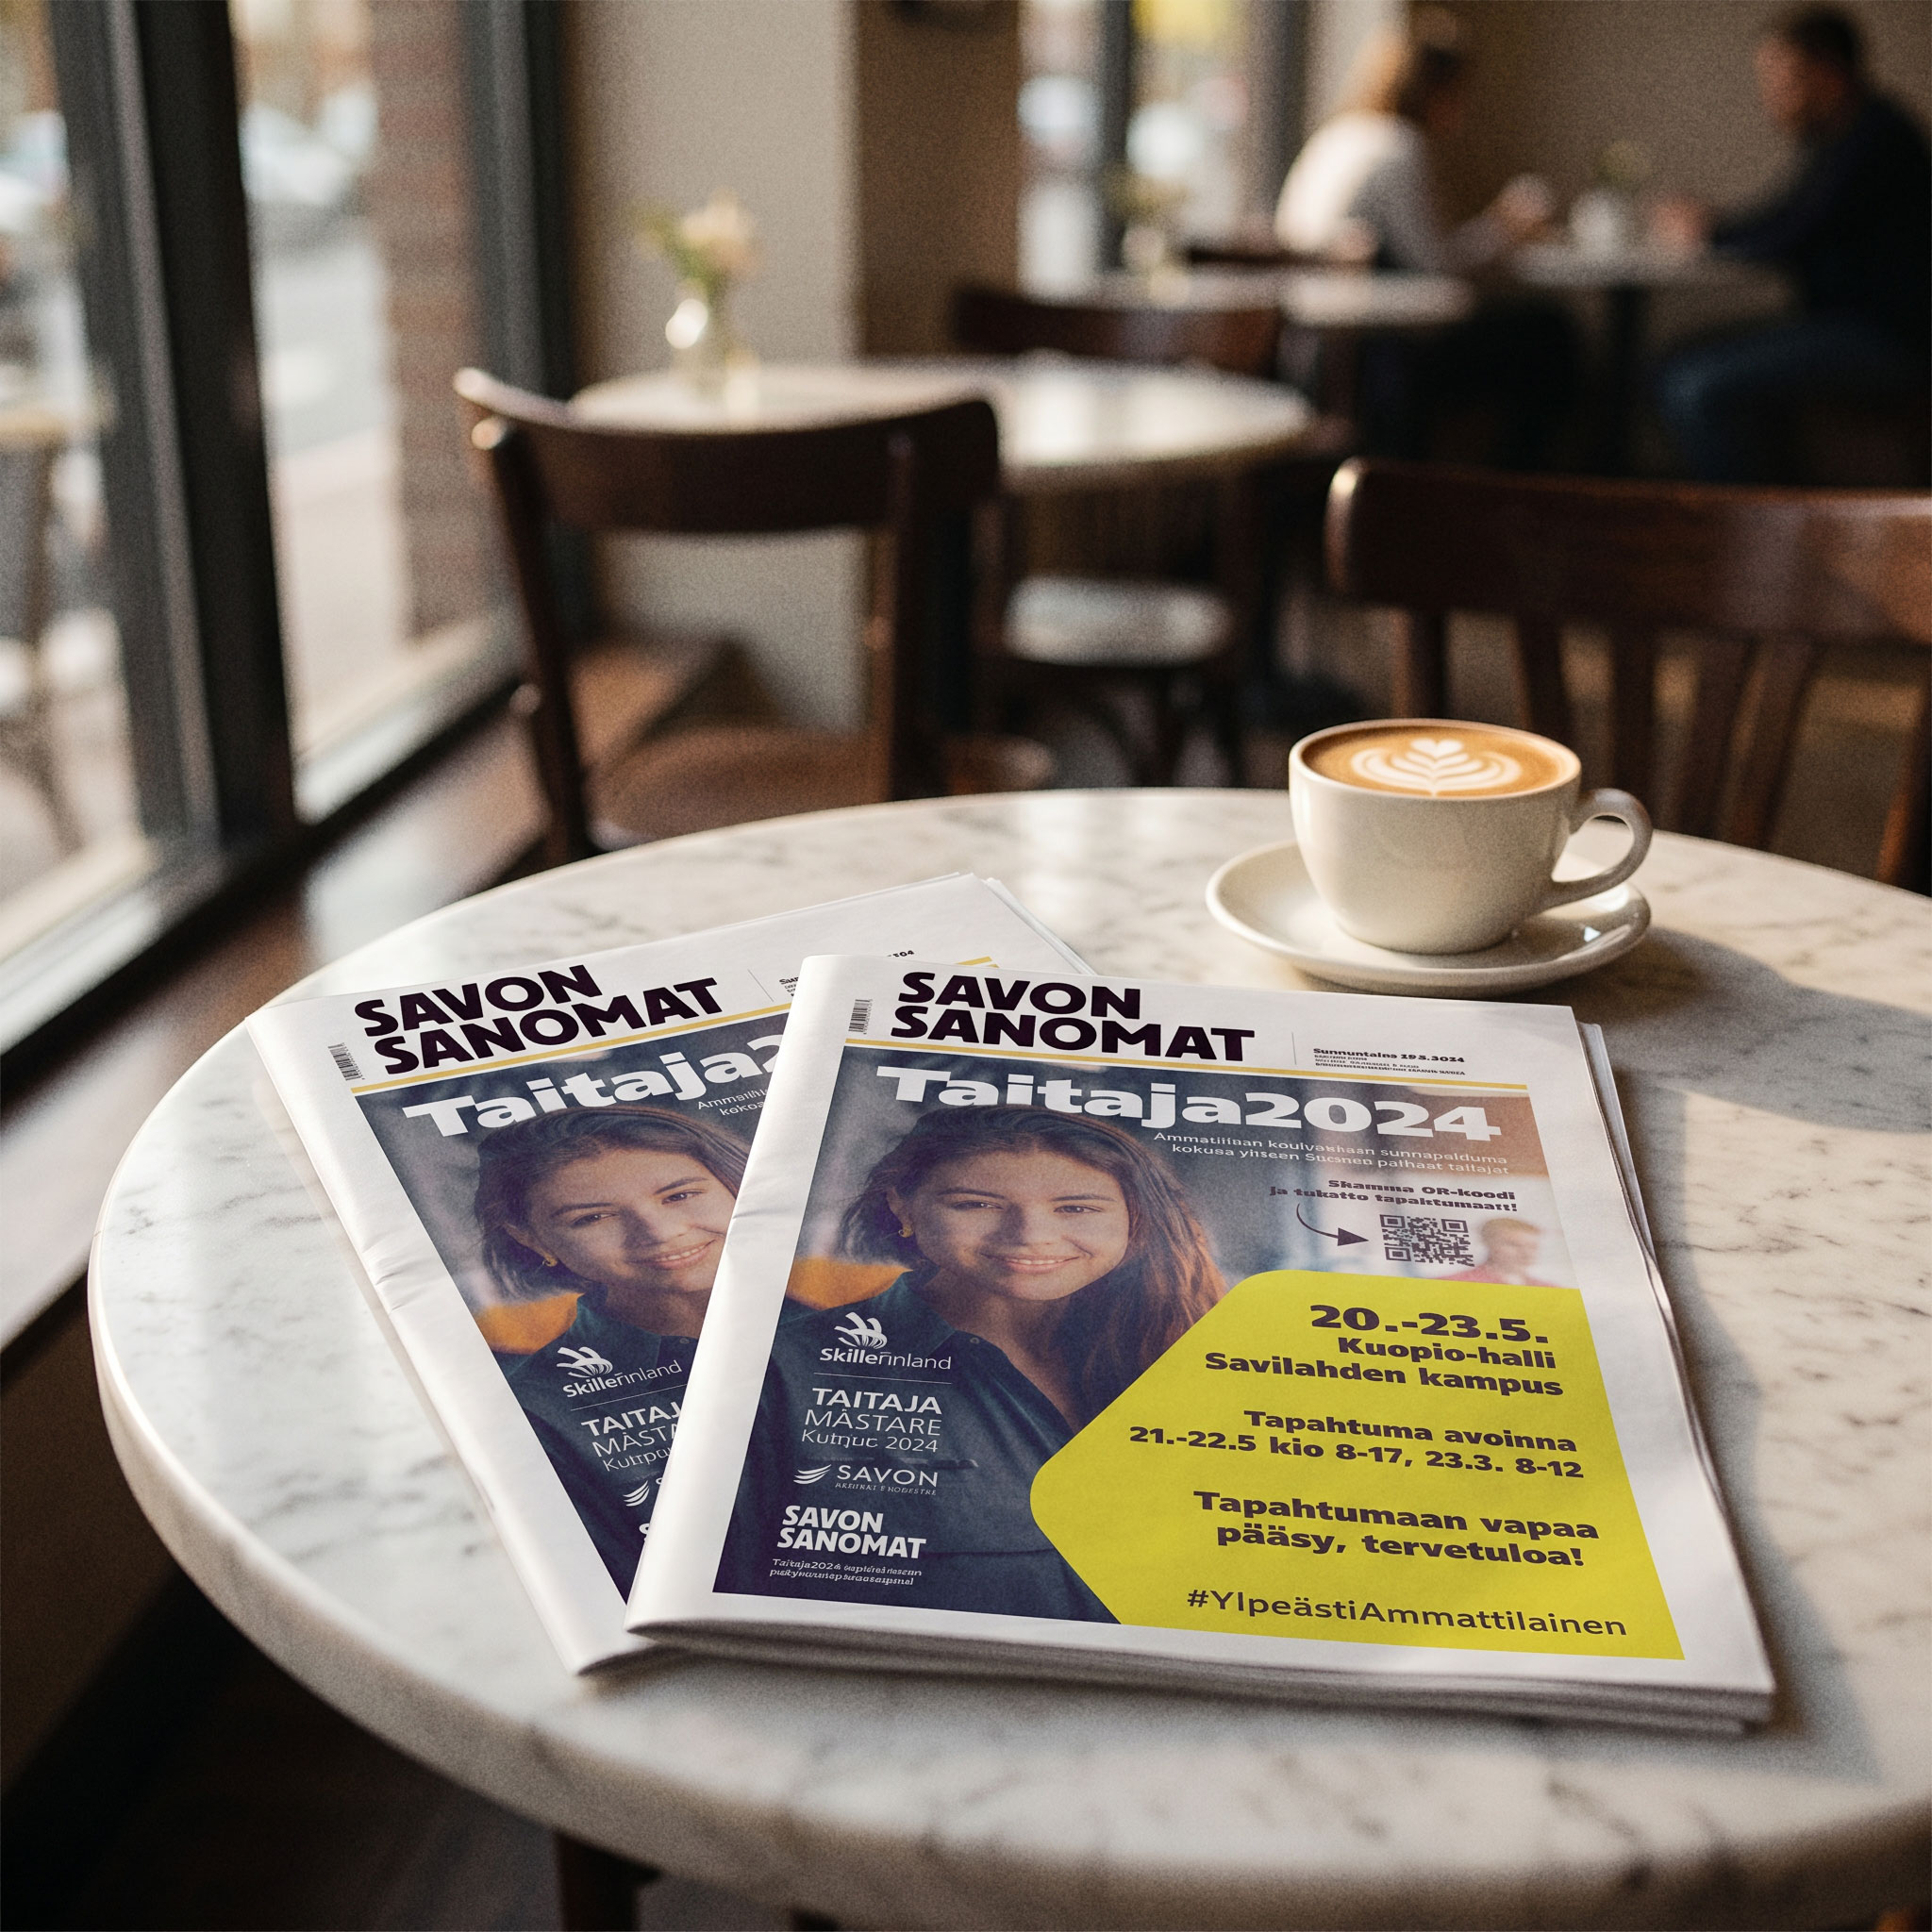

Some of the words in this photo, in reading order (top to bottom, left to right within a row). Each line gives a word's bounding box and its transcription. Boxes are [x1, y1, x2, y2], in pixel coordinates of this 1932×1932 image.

[354, 964, 603, 1037] SAVON
[897, 972, 1141, 1019] SAVON
[374, 976, 723, 1074] SANOMAT
[891, 1006, 1254, 1061] SANOMAT
[875, 1066, 1501, 1142] Taitaja2024
[1309, 1305, 1549, 1343] 20.-23.5.
[1205, 1352, 1406, 1384] Savilahden
[1420, 1368, 1564, 1396] kampus
[1338, 1337, 1557, 1369] Kuopio-halli
[812, 1388, 942, 1415] TAITAJA
[885, 1436, 938, 1453] 2024
[1129, 1426, 1257, 1452] 21.-22.5
[1336, 1443, 1413, 1467] 8-17,
[1424, 1451, 1504, 1473] 23.3.
[1515, 1457, 1584, 1478] 8-12
[1243, 1410, 1433, 1441] Tapahtuma
[1444, 1429, 1577, 1452] avoinna
[837, 1465, 938, 1488] SAVON
[782, 1505, 884, 1533] SAVON
[1193, 1491, 1468, 1531] Tapahtumaan
[1480, 1515, 1599, 1541] vapaa
[777, 1527, 927, 1558] SANOMAT
[1216, 1523, 1346, 1555] pääsy,
[1362, 1533, 1585, 1566] tervetuloa!
[1187, 1589, 1627, 1637] #YlpeästiAmmattilainen
